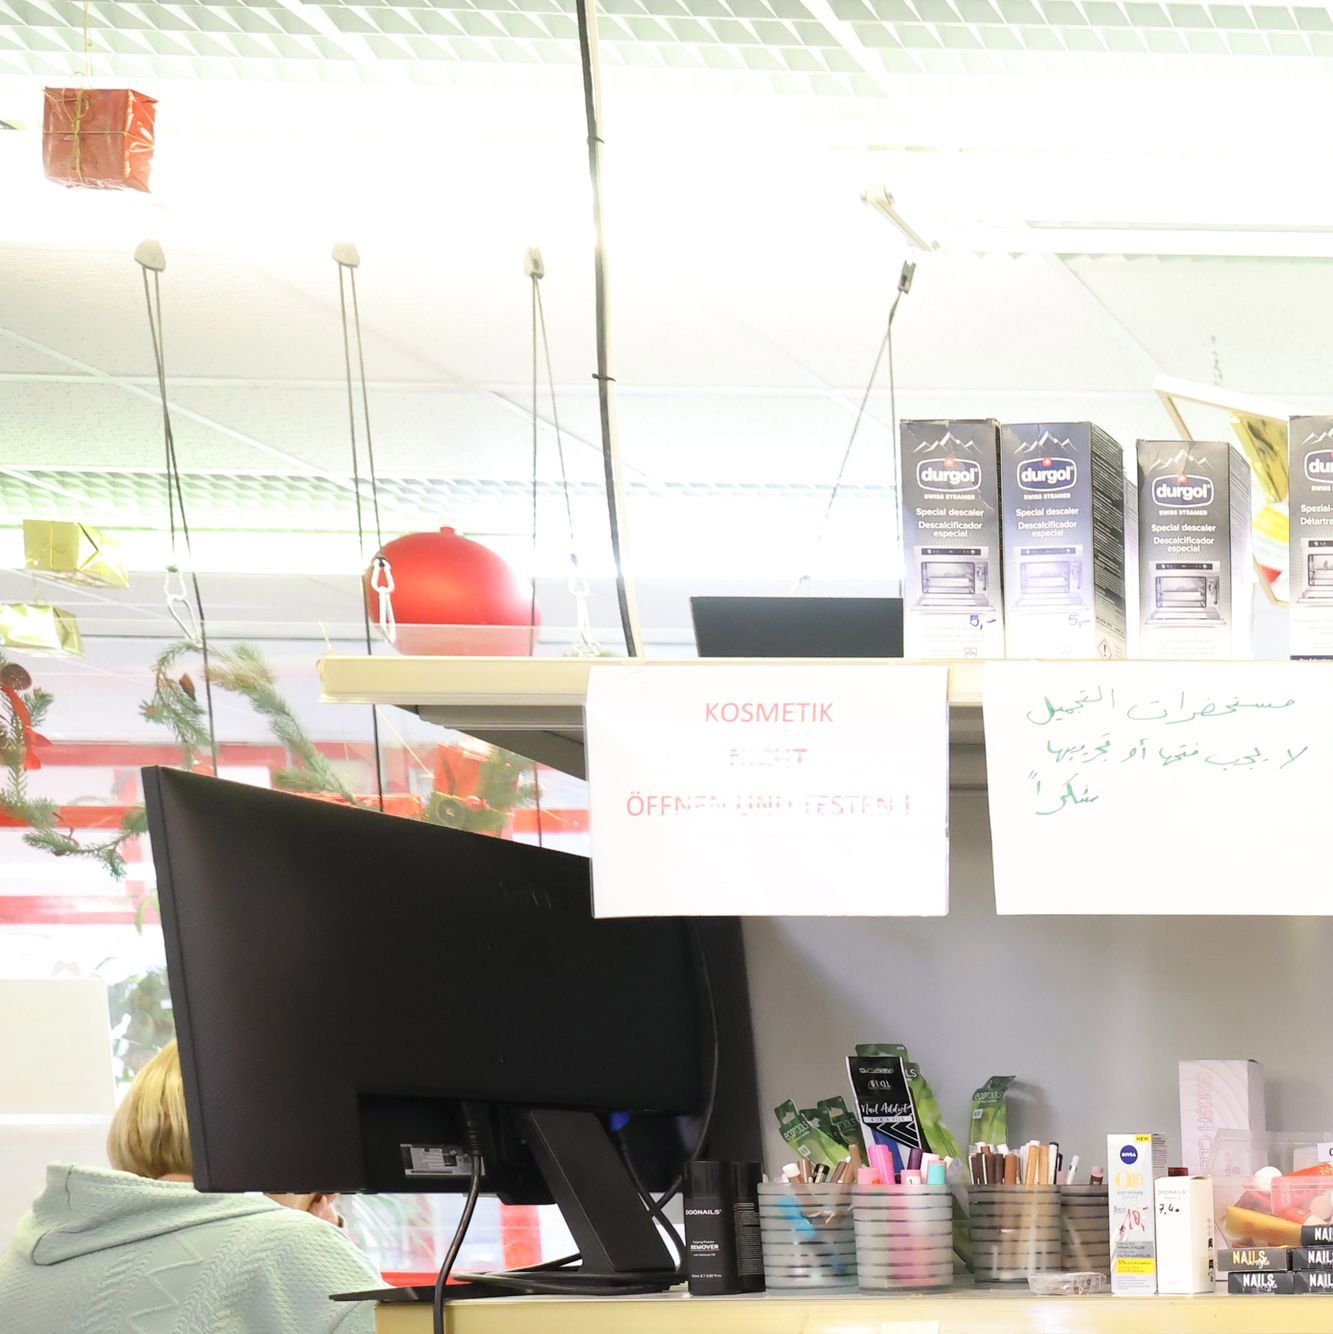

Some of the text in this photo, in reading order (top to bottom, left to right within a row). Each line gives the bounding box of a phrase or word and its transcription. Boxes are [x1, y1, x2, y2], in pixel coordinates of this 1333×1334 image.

[921, 467, 974, 484] durgol
[1021, 467, 1071, 484] durgol
[1156, 483, 1207, 500] durgol
[916, 508, 984, 517] Special descaler
[1016, 507, 1079, 517] Special descaler
[918, 521, 982, 530] Descalcificador
[1018, 520, 1078, 530] Descalcificador
[1151, 524, 1216, 532] Special descaler
[933, 530, 968, 538] especial
[1032, 529, 1064, 538] especial
[1153, 536, 1214, 545] Descalcificador
[1167, 544, 1200, 553] especial
[705, 703, 833, 722] KOSMETIK
[1233, 1250, 1265, 1263] NAILS
[1243, 1274, 1274, 1286] NAILS
